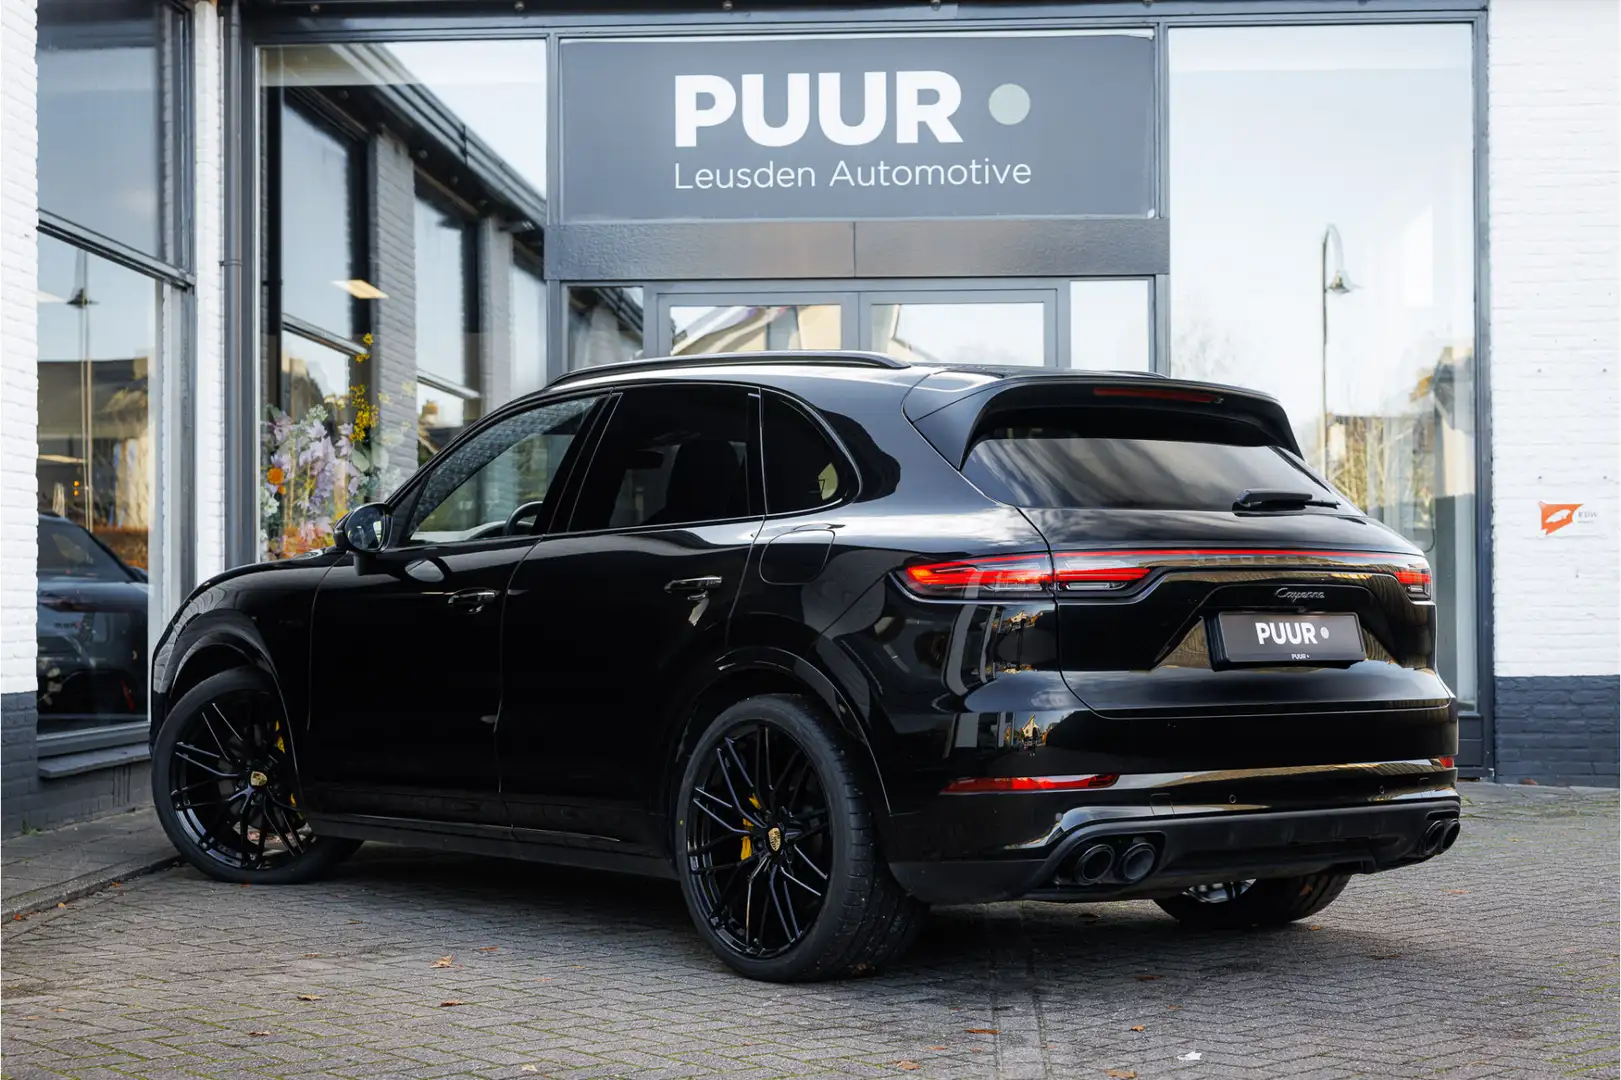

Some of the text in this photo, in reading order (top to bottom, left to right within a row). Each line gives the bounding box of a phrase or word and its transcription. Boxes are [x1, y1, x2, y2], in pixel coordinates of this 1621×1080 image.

[674, 70, 964, 147] PUUR
[674, 157, 1032, 190] Leusden Automotive
[1275, 587, 1325, 603] Cayenne
[1255, 622, 1318, 645] PUUR
